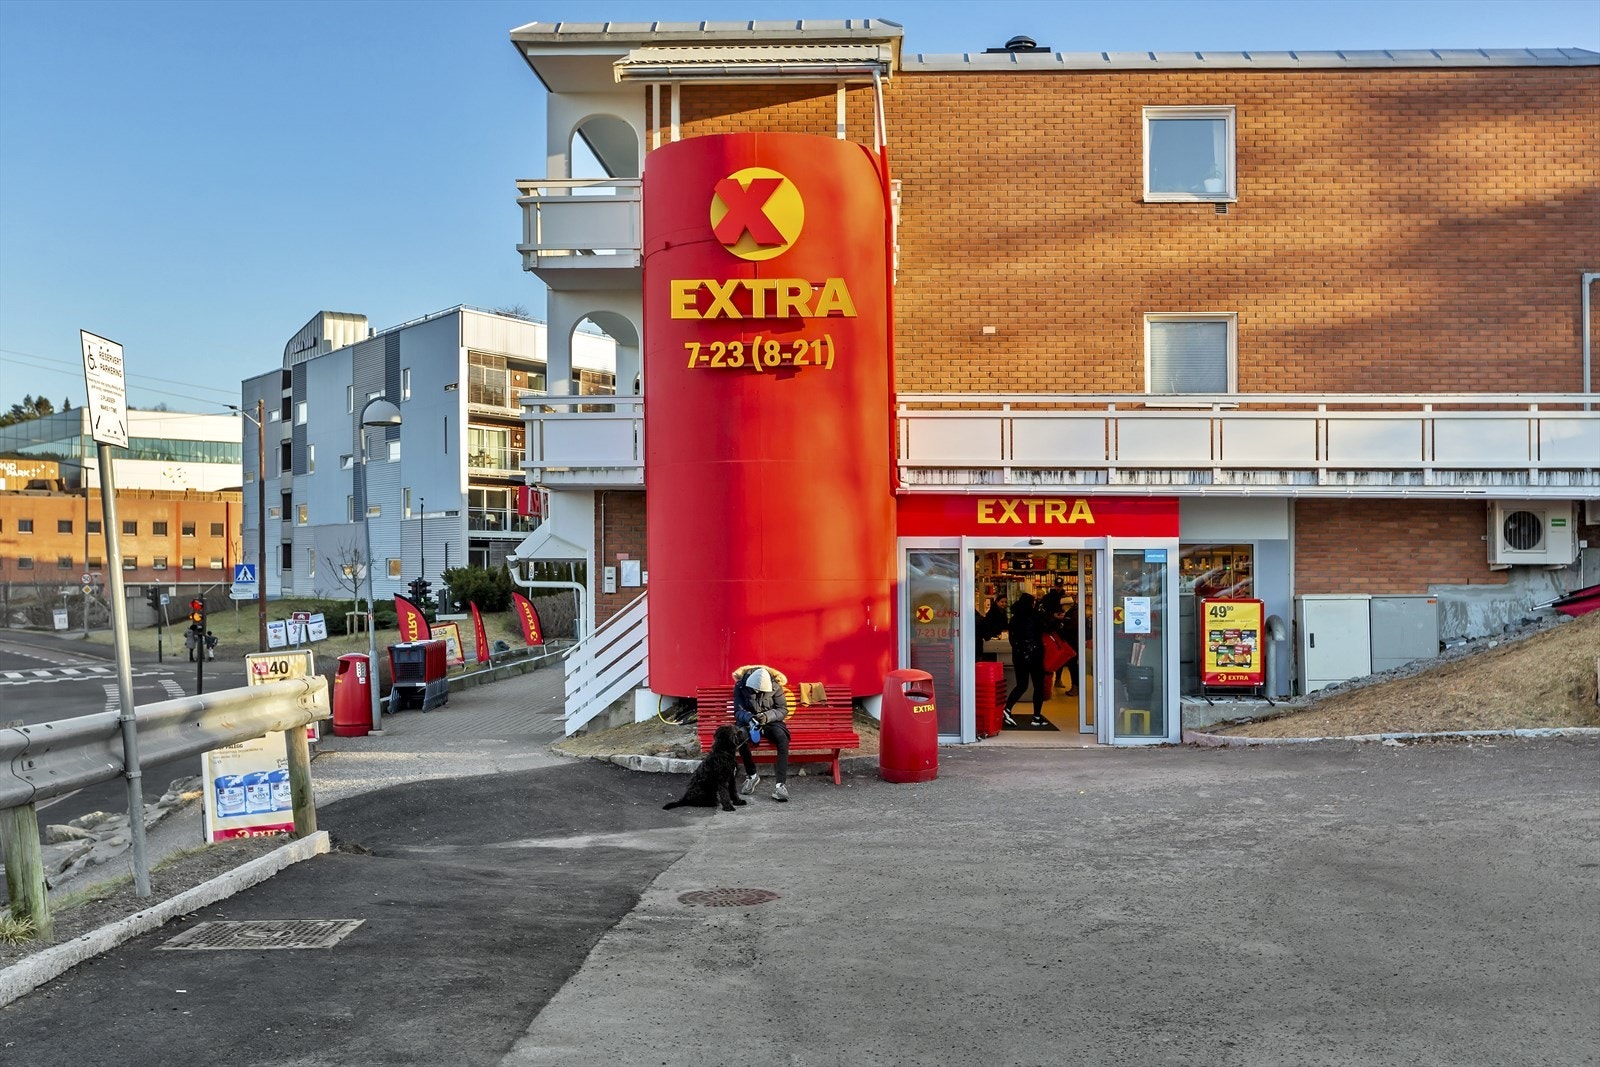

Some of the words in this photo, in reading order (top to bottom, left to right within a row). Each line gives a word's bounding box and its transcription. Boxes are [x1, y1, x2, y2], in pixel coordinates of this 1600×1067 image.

[671, 278, 857, 319] EXTRA
[684, 340, 745, 369] 7-23
[752, 334, 836, 372] (8-21)
[6, 469, 30, 477] PARK
[977, 499, 1096, 525] EXTRA
[1210, 605, 1227, 618] 49
[917, 628, 936, 637] 7-23
[938, 628, 960, 638] (821
[269, 660, 289, 675] 40
[913, 704, 935, 713] EXTRA
